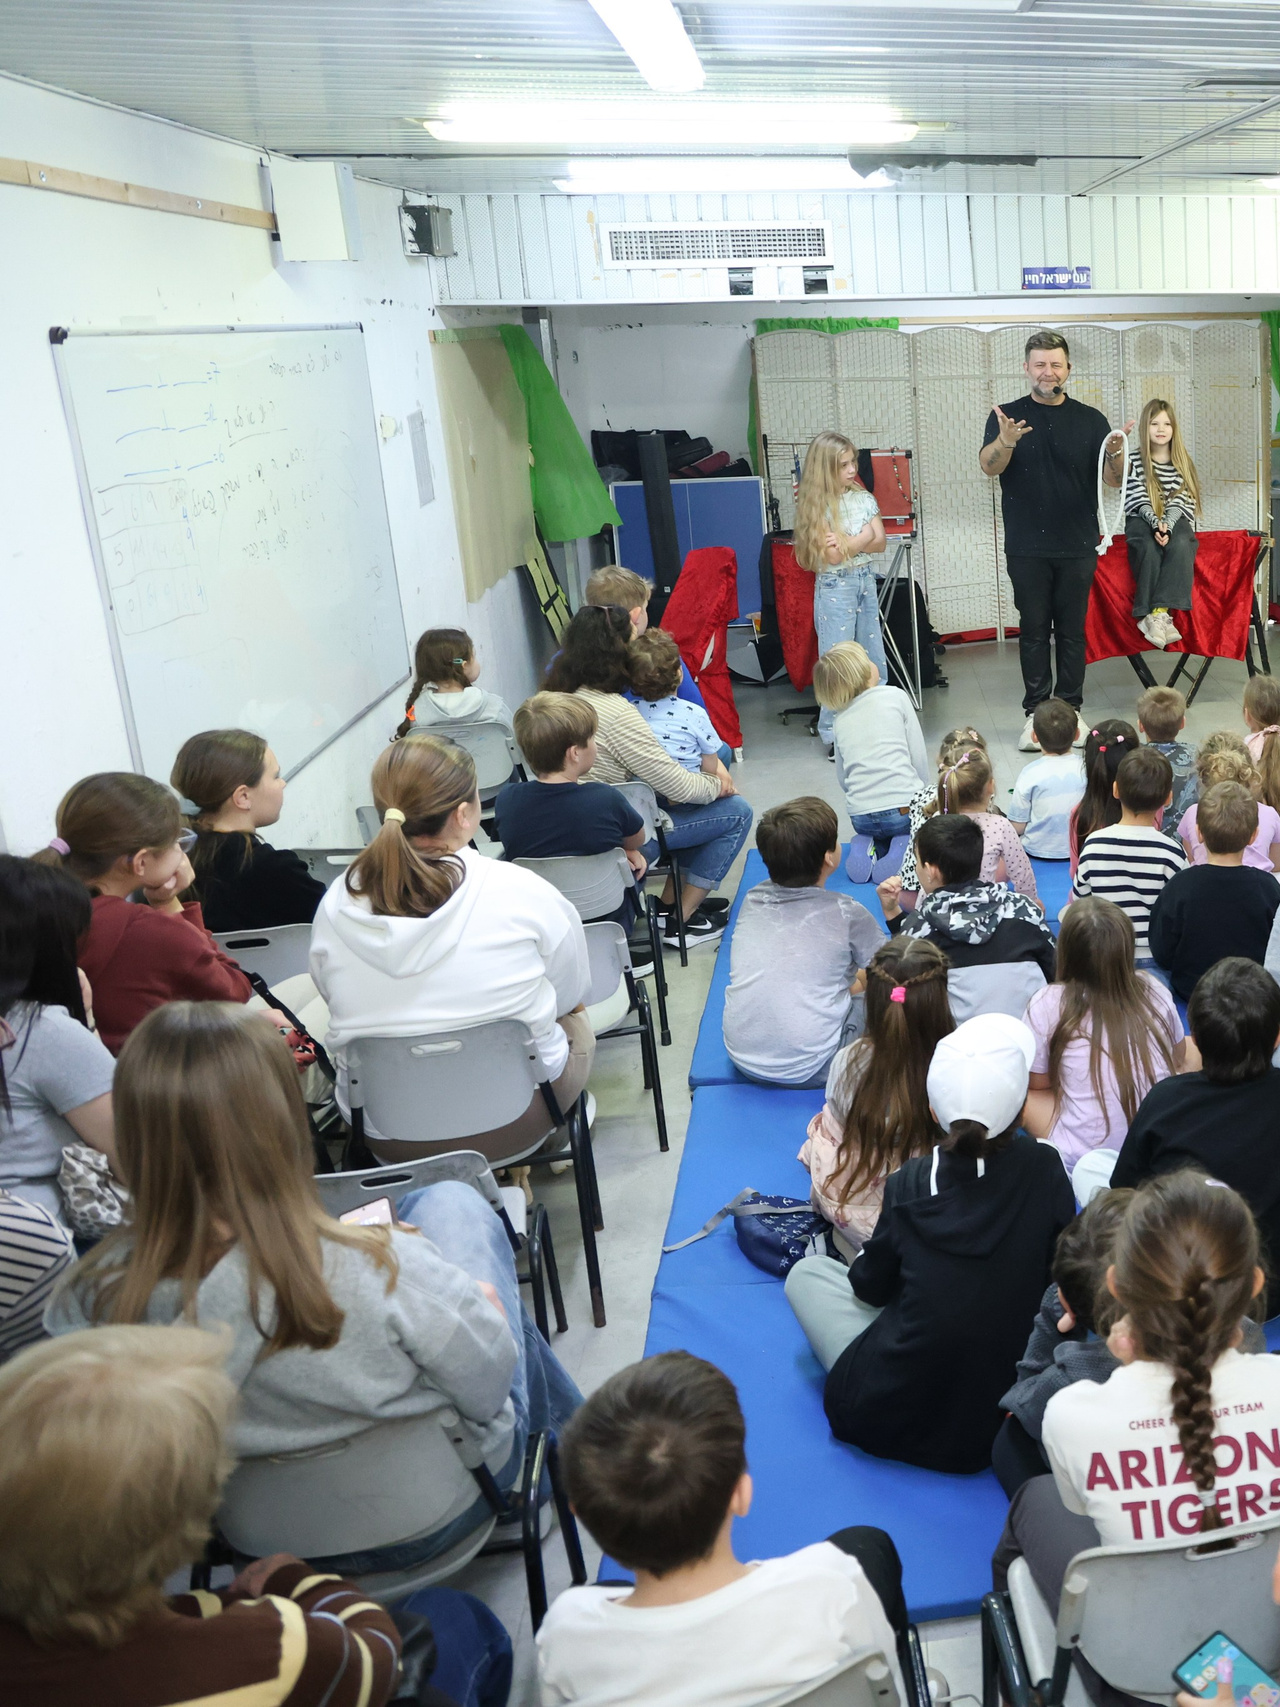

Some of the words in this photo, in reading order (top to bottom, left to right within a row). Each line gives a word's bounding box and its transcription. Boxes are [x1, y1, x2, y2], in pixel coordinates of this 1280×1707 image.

[1024, 274, 1040, 285] חי!
[1040, 272, 1072, 284] ישראל
[1073, 273, 1087, 284] עם
[1128, 1418, 1166, 1431] CHEER
[1233, 1401, 1265, 1416] TEAM
